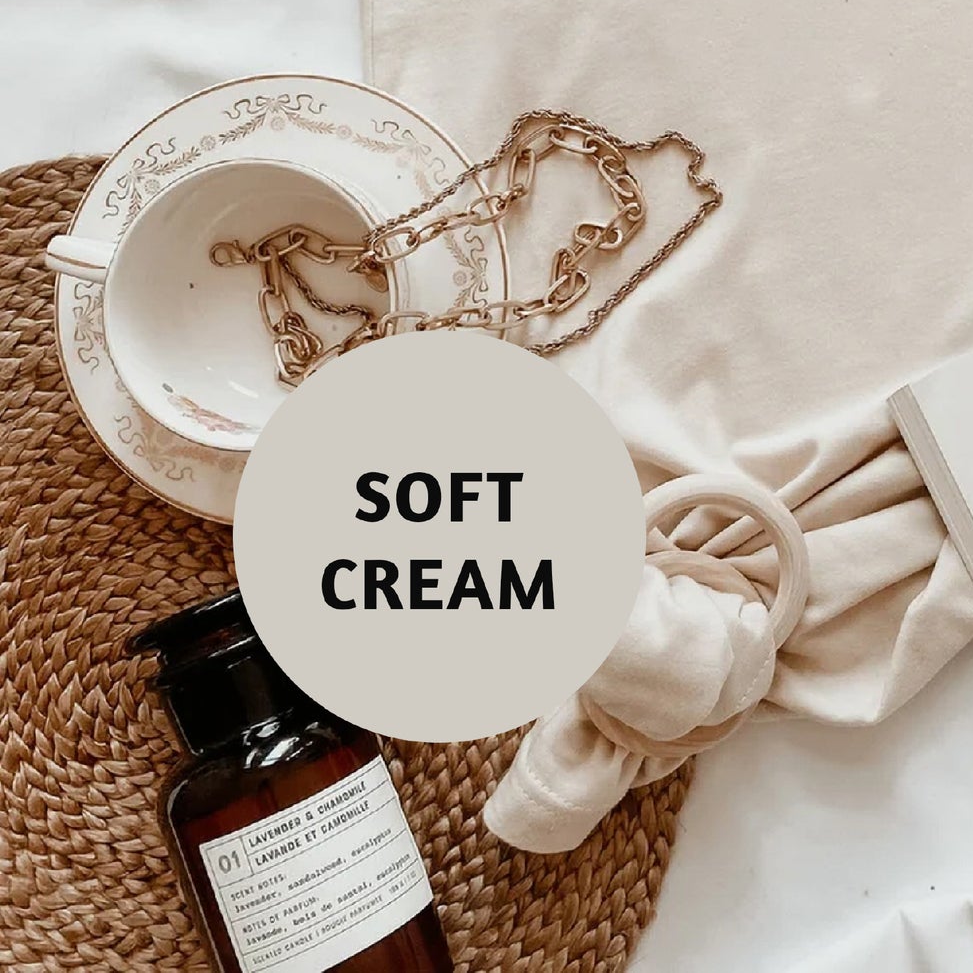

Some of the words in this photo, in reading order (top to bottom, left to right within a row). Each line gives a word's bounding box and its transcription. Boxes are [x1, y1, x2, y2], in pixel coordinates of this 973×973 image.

[248, 817, 302, 848] LAVENDER
[318, 781, 367, 815] CHAMOMILE
[254, 839, 302, 866] LAVANDE
[304, 831, 316, 843] ET
[320, 800, 370, 834] CAMOMILLE
[218, 851, 241, 874] 01
